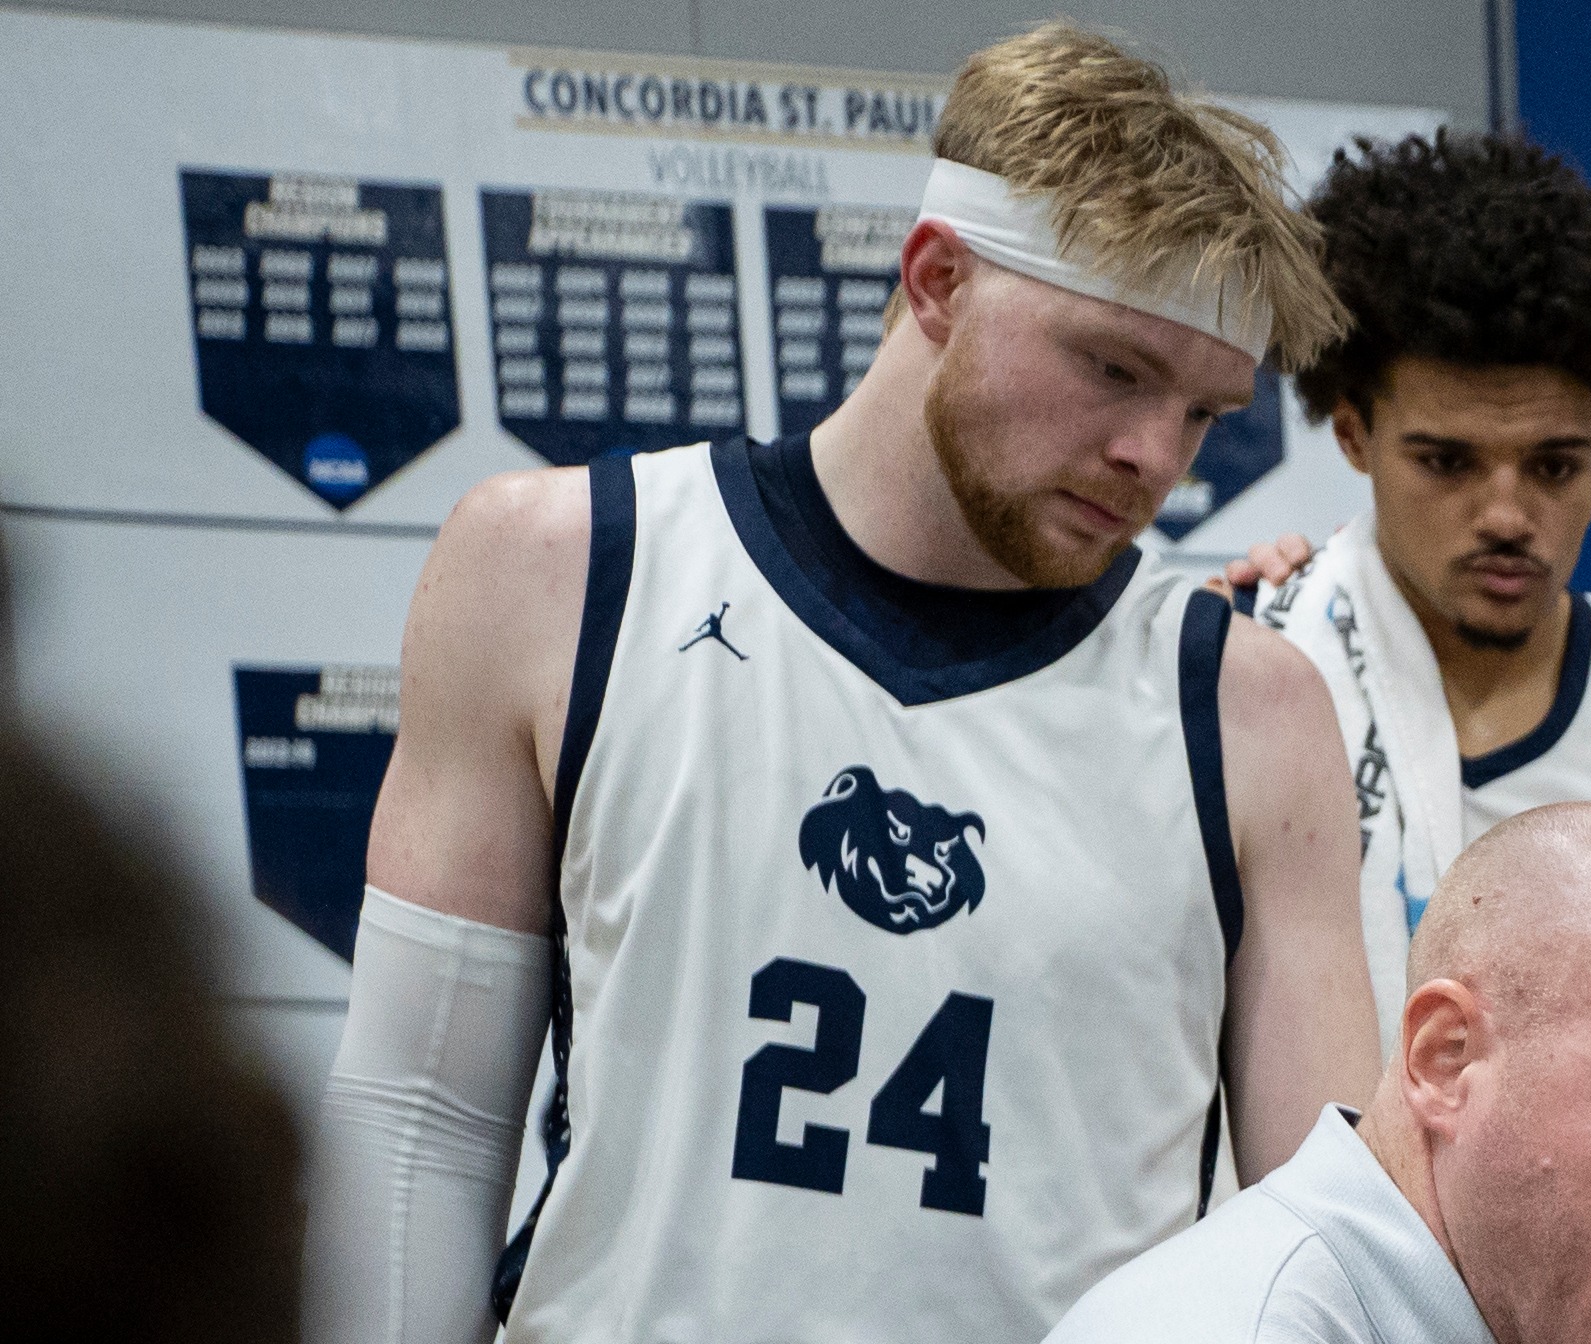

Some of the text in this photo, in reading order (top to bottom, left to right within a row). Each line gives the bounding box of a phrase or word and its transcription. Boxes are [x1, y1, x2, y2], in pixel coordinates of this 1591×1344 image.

[524, 69, 768, 124] CONCORDIA
[782, 86, 833, 131] ST.
[648, 147, 830, 195] VOLLEYBALL
[731, 956, 994, 1217] 24
